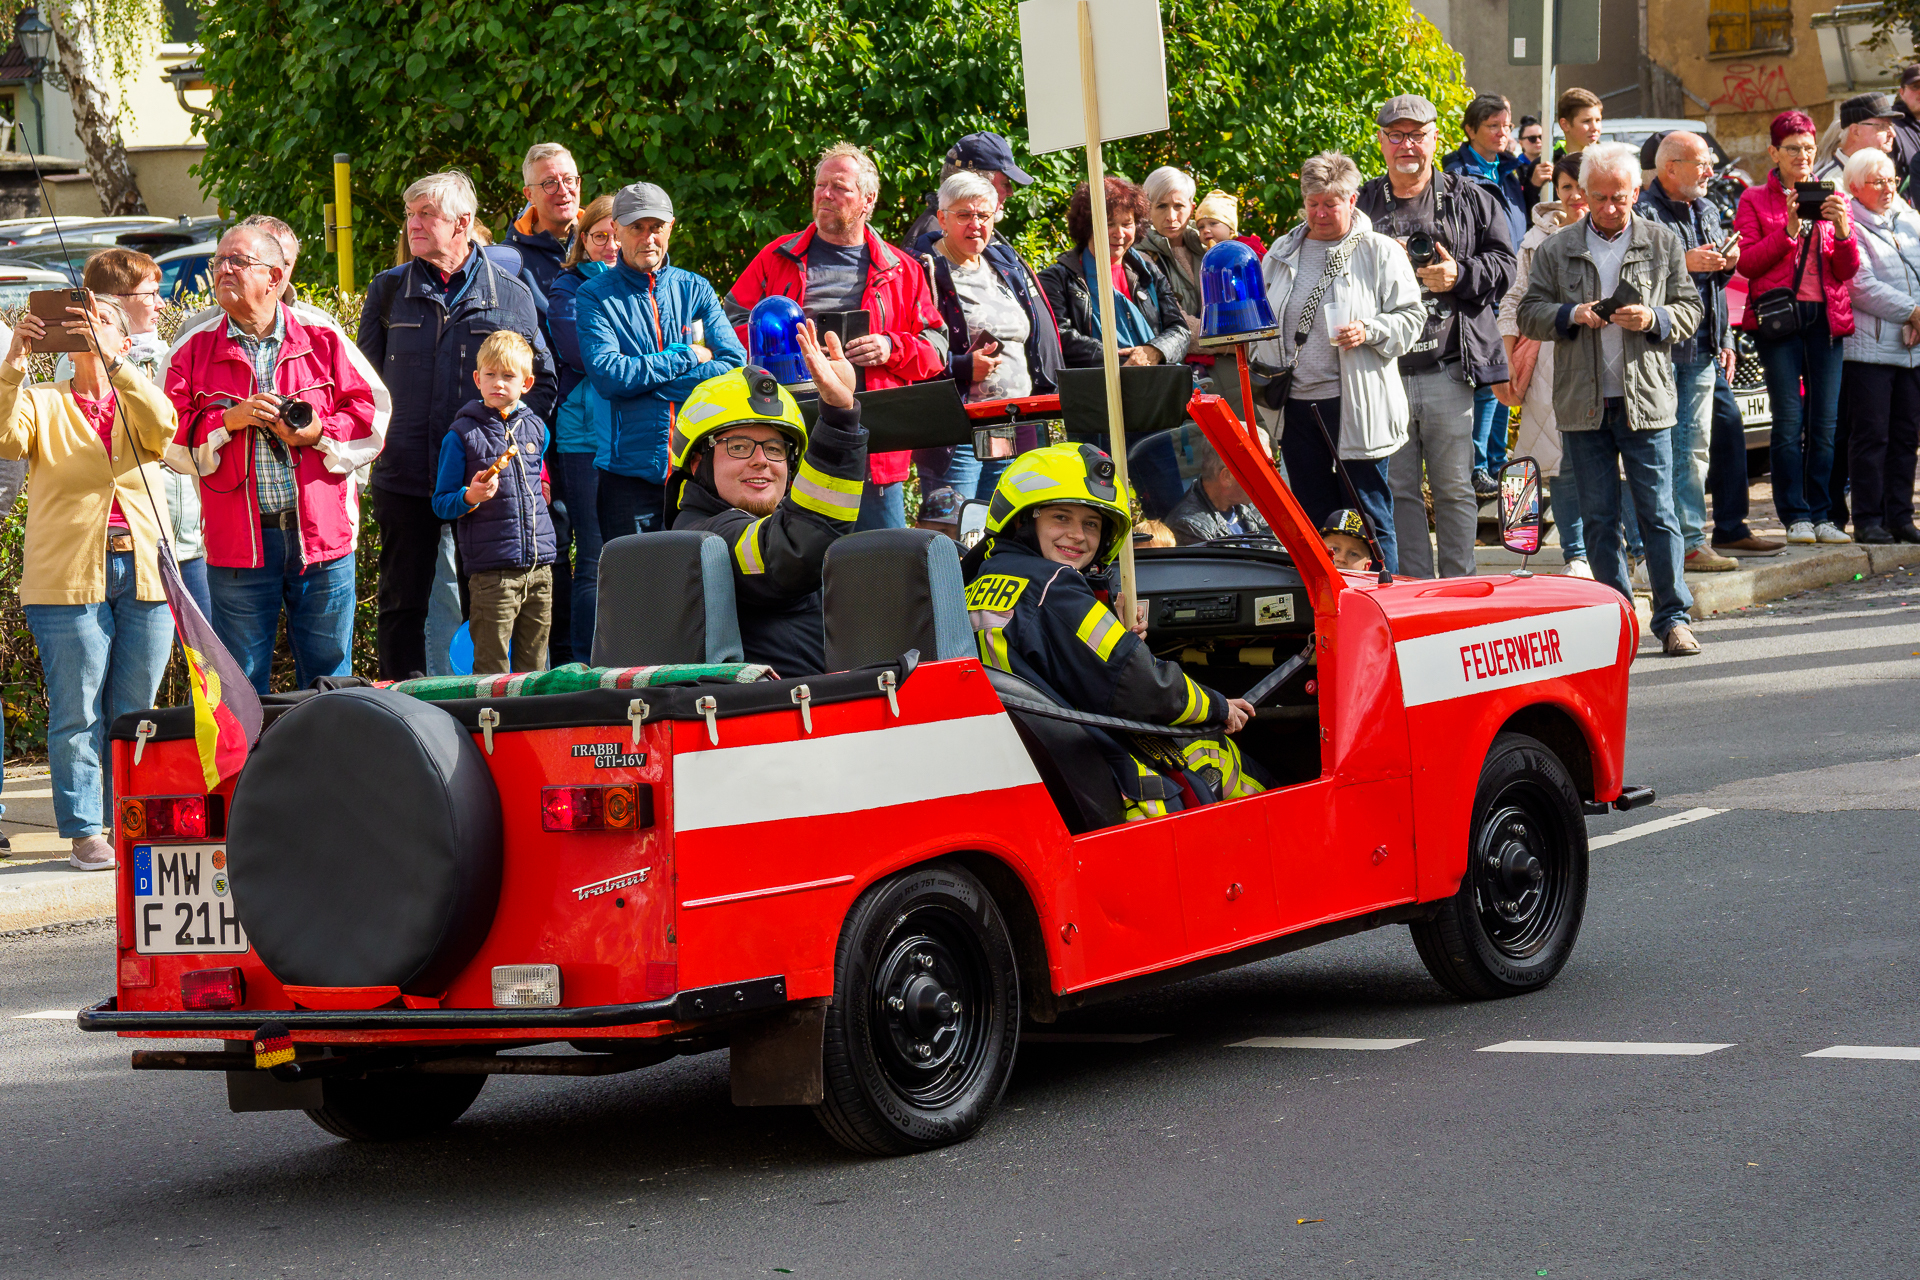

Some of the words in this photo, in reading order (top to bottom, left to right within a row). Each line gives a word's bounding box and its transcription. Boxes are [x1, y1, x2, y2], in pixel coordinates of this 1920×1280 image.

[1747, 397, 1765, 416] HW
[1459, 628, 1563, 682] FEUERWEHR
[571, 743, 619, 757] TRABBI
[594, 753, 645, 768] GTI-16V
[140, 877, 148, 890] D
[157, 852, 201, 896] MW
[572, 866, 651, 901] Trabant
[143, 903, 164, 946] F
[174, 901, 241, 945] 21H
